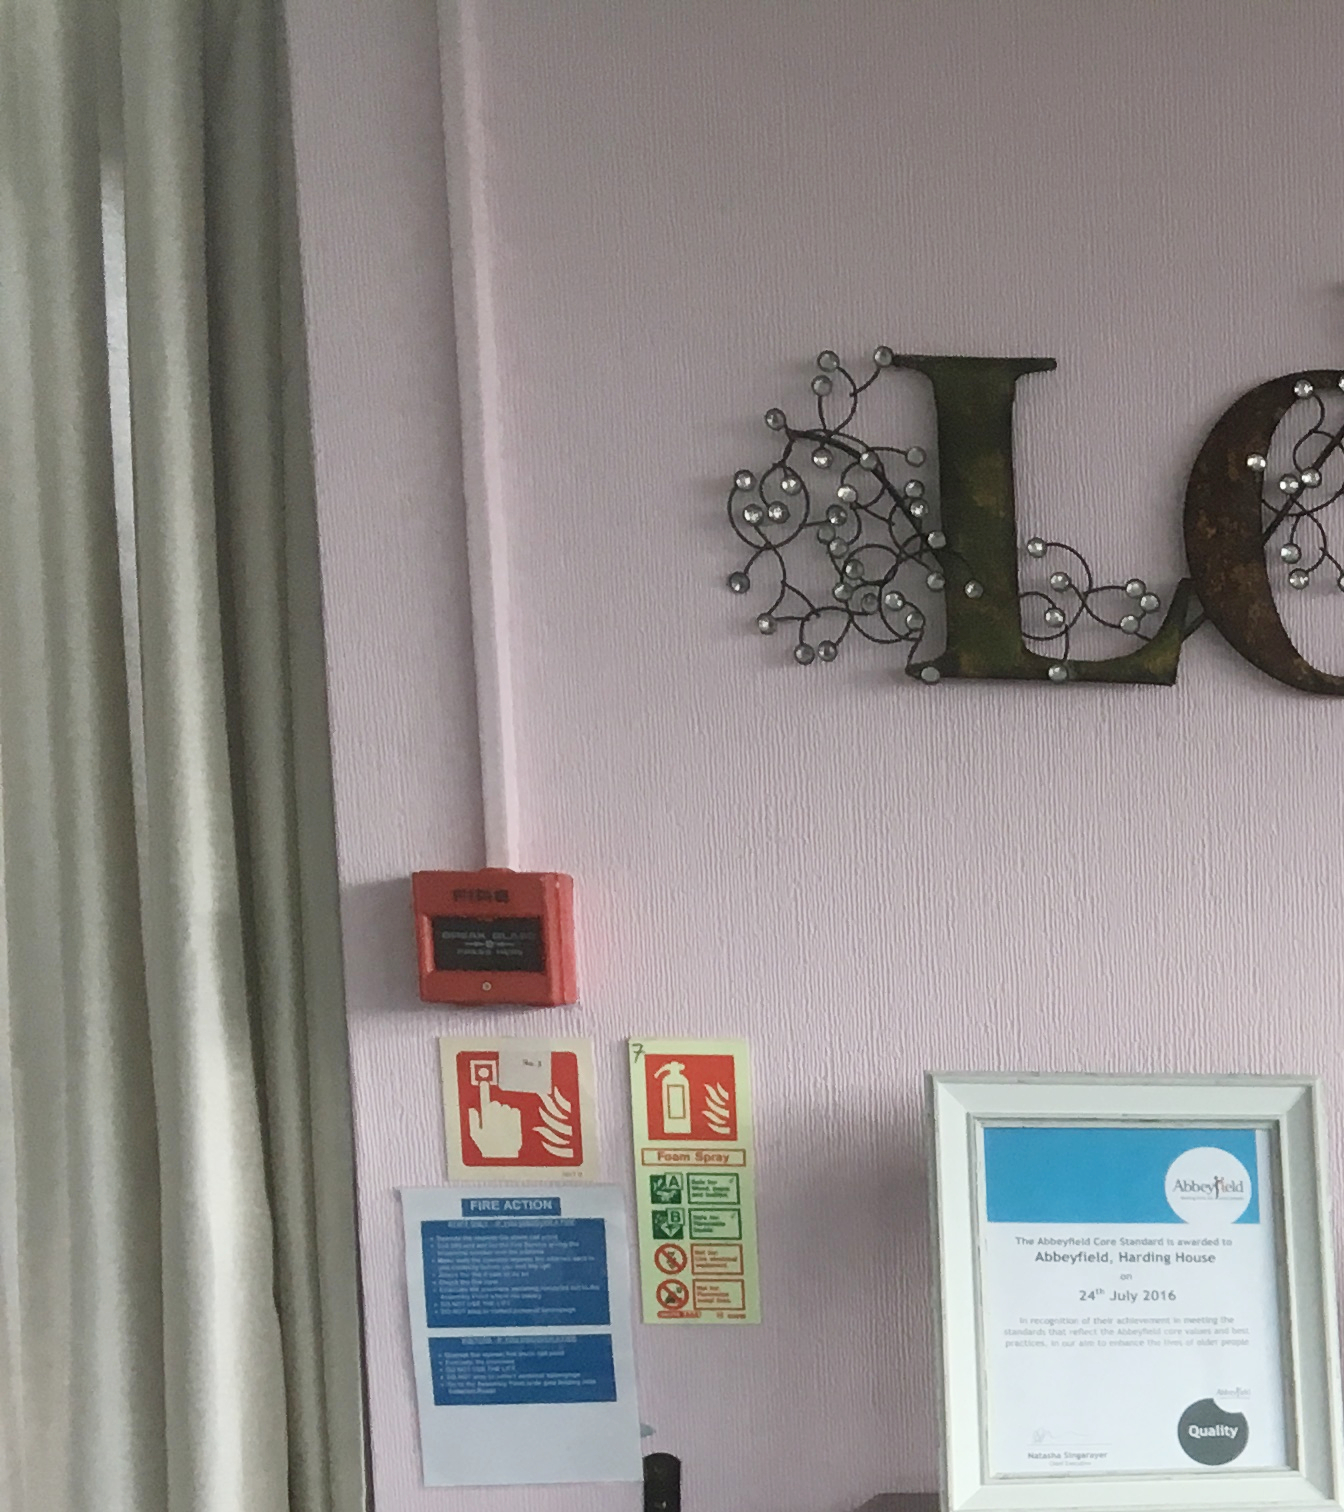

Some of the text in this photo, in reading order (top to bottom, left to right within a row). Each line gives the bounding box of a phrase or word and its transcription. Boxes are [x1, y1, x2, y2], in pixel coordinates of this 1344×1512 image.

[657, 1150, 730, 1164] Foam Spray
[1172, 1176, 1245, 1200] Abbeyfield
[470, 1199, 553, 1212] FIRE ACTION
[1015, 1236, 1233, 1248] The Abbeyfield Core Standard is awarded to
[1035, 1251, 1217, 1266] Abbeyfield, Harding House
[1120, 1273, 1133, 1281] on
[1109, 1290, 1139, 1304] July
[1143, 1290, 1177, 1302] 2016
[1030, 1317, 1079, 1327] recognition
[1081, 1317, 1091, 1325] of
[1184, 1317, 1218, 1327] meeting
[1220, 1316, 1235, 1325] the
[1188, 1425, 1239, 1439] Quality
[1027, 1451, 1062, 1459] Natasha
